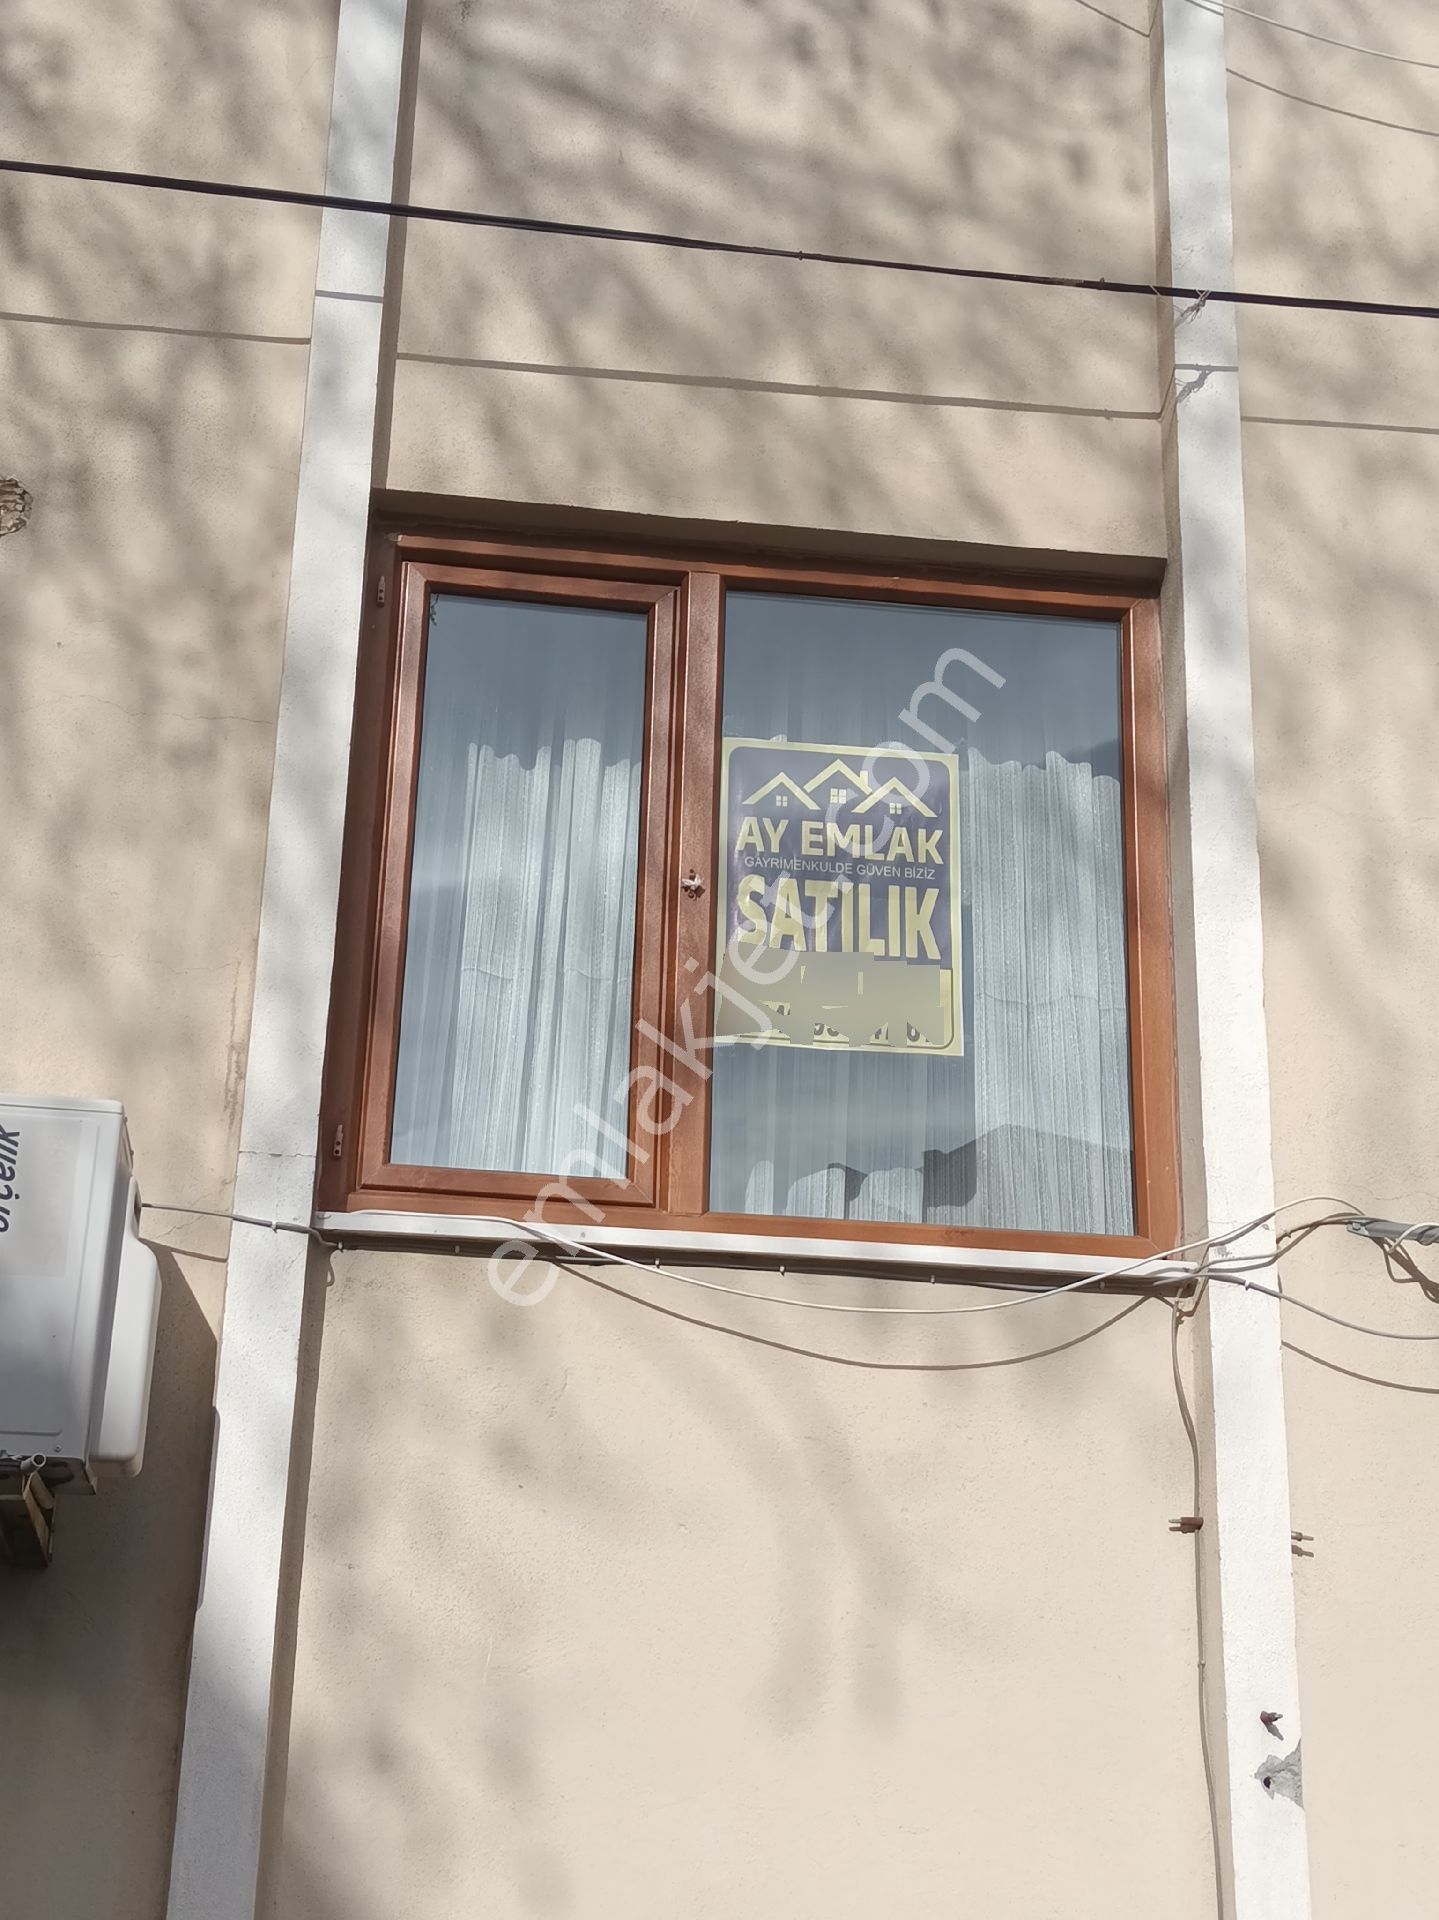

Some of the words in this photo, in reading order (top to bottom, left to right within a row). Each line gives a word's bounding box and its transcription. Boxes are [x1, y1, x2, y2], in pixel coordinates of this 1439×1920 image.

[735, 816, 789, 853] AY
[801, 820, 944, 864] EMLAK
[856, 863, 901, 877] GÜVEN
[736, 874, 942, 960] SATILIK
